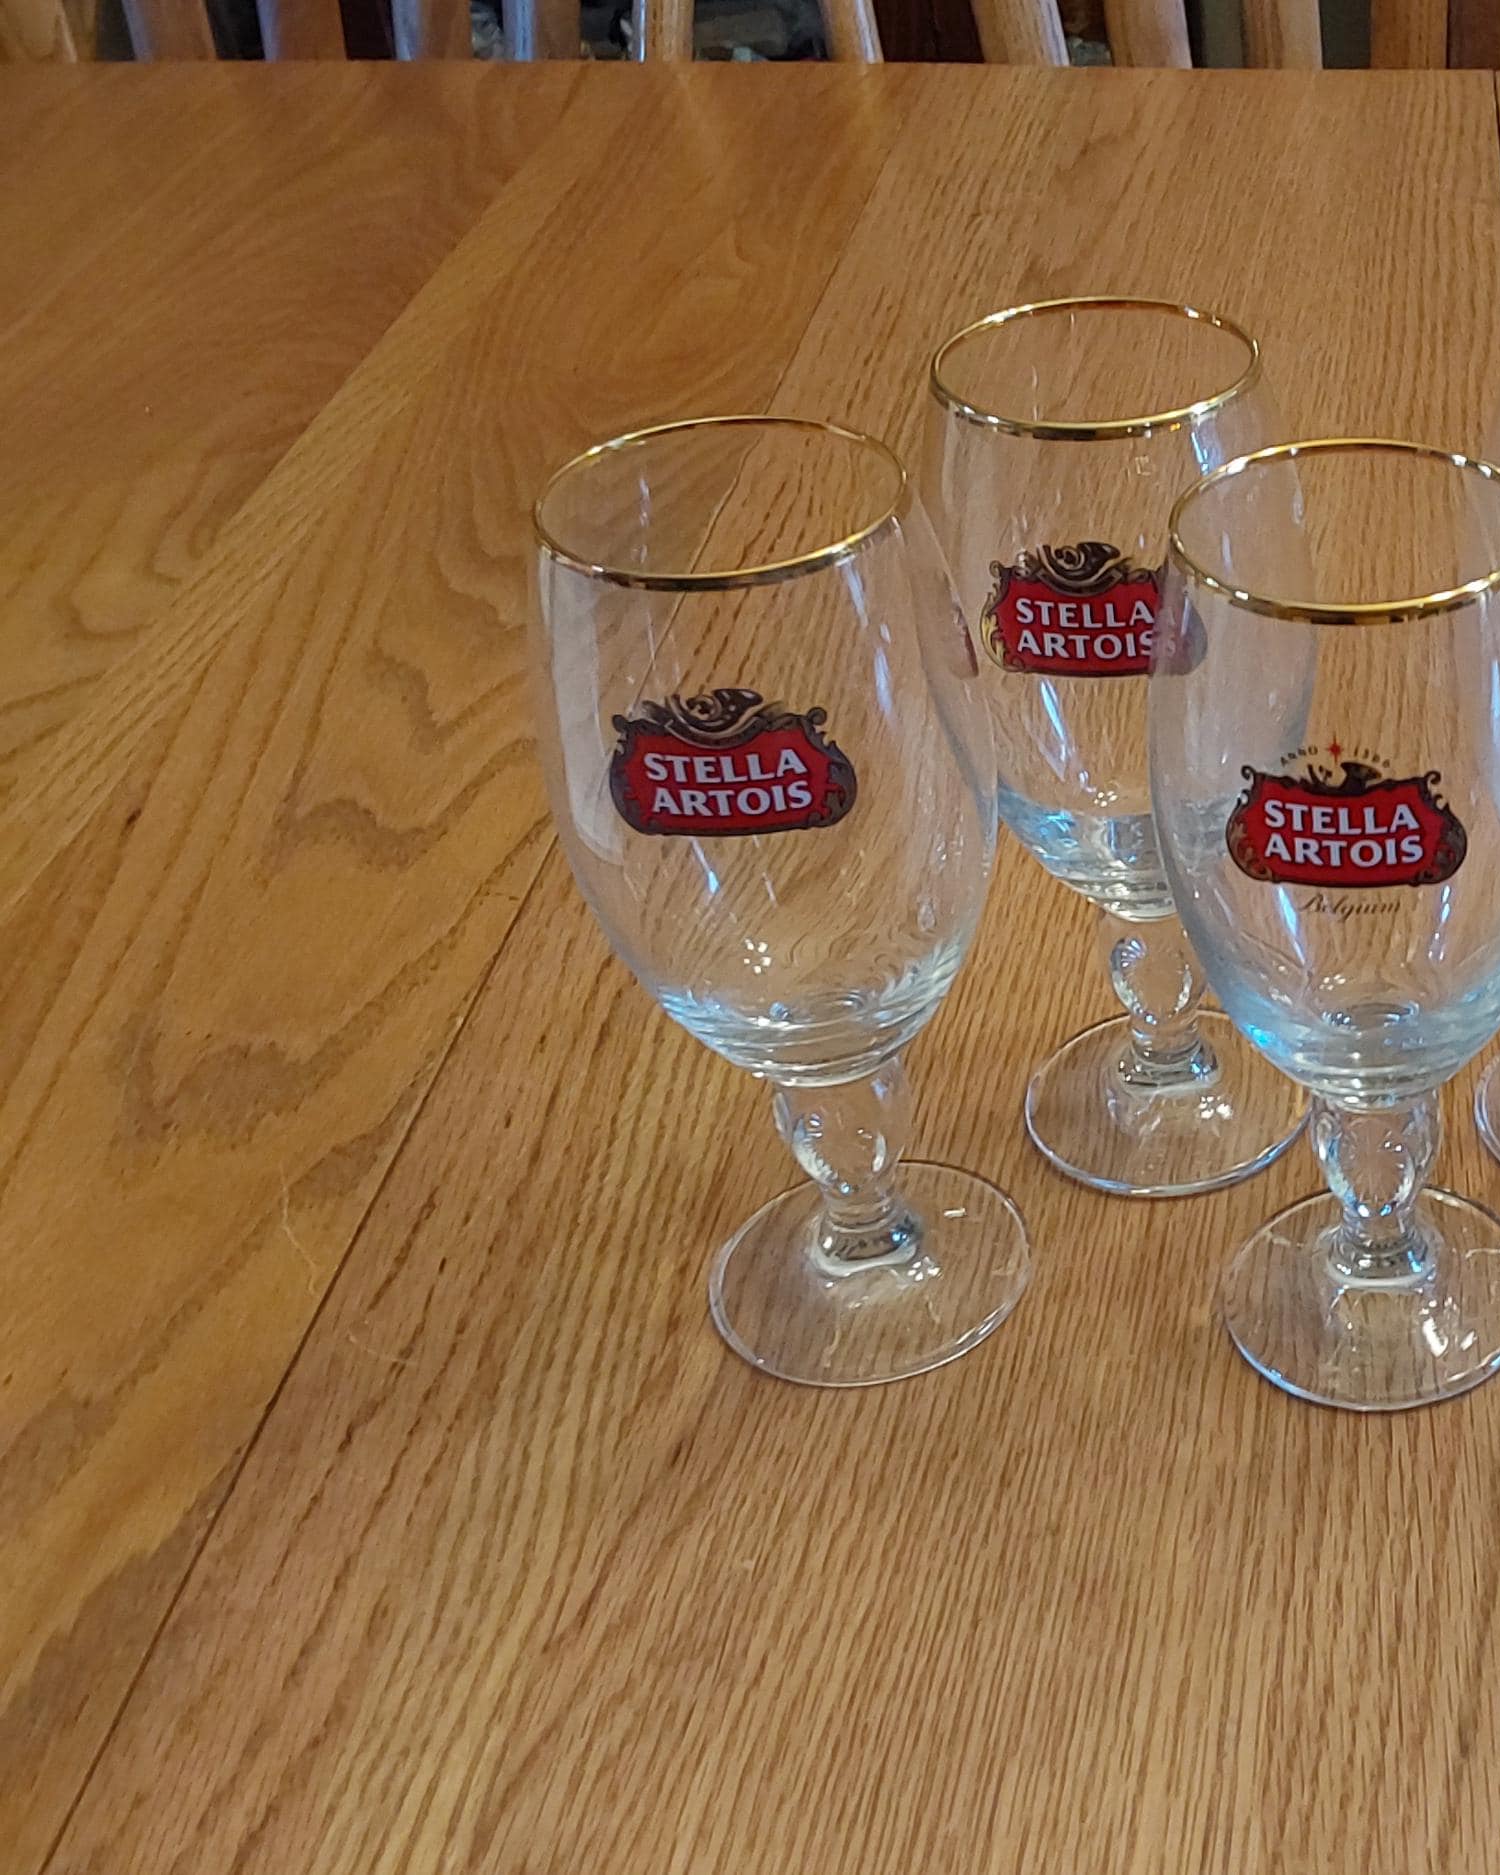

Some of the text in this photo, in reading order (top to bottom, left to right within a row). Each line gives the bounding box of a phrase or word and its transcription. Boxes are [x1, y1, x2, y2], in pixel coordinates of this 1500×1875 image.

[1016, 598, 1155, 629] STELLA
[1017, 629, 1155, 660] ARTOIS
[643, 749, 808, 784] STELLA
[652, 780, 813, 817] ARTOIS
[1263, 799, 1420, 836] STELLA
[1264, 833, 1424, 868] ARTOIS
[1299, 893, 1400, 922] Belgium
